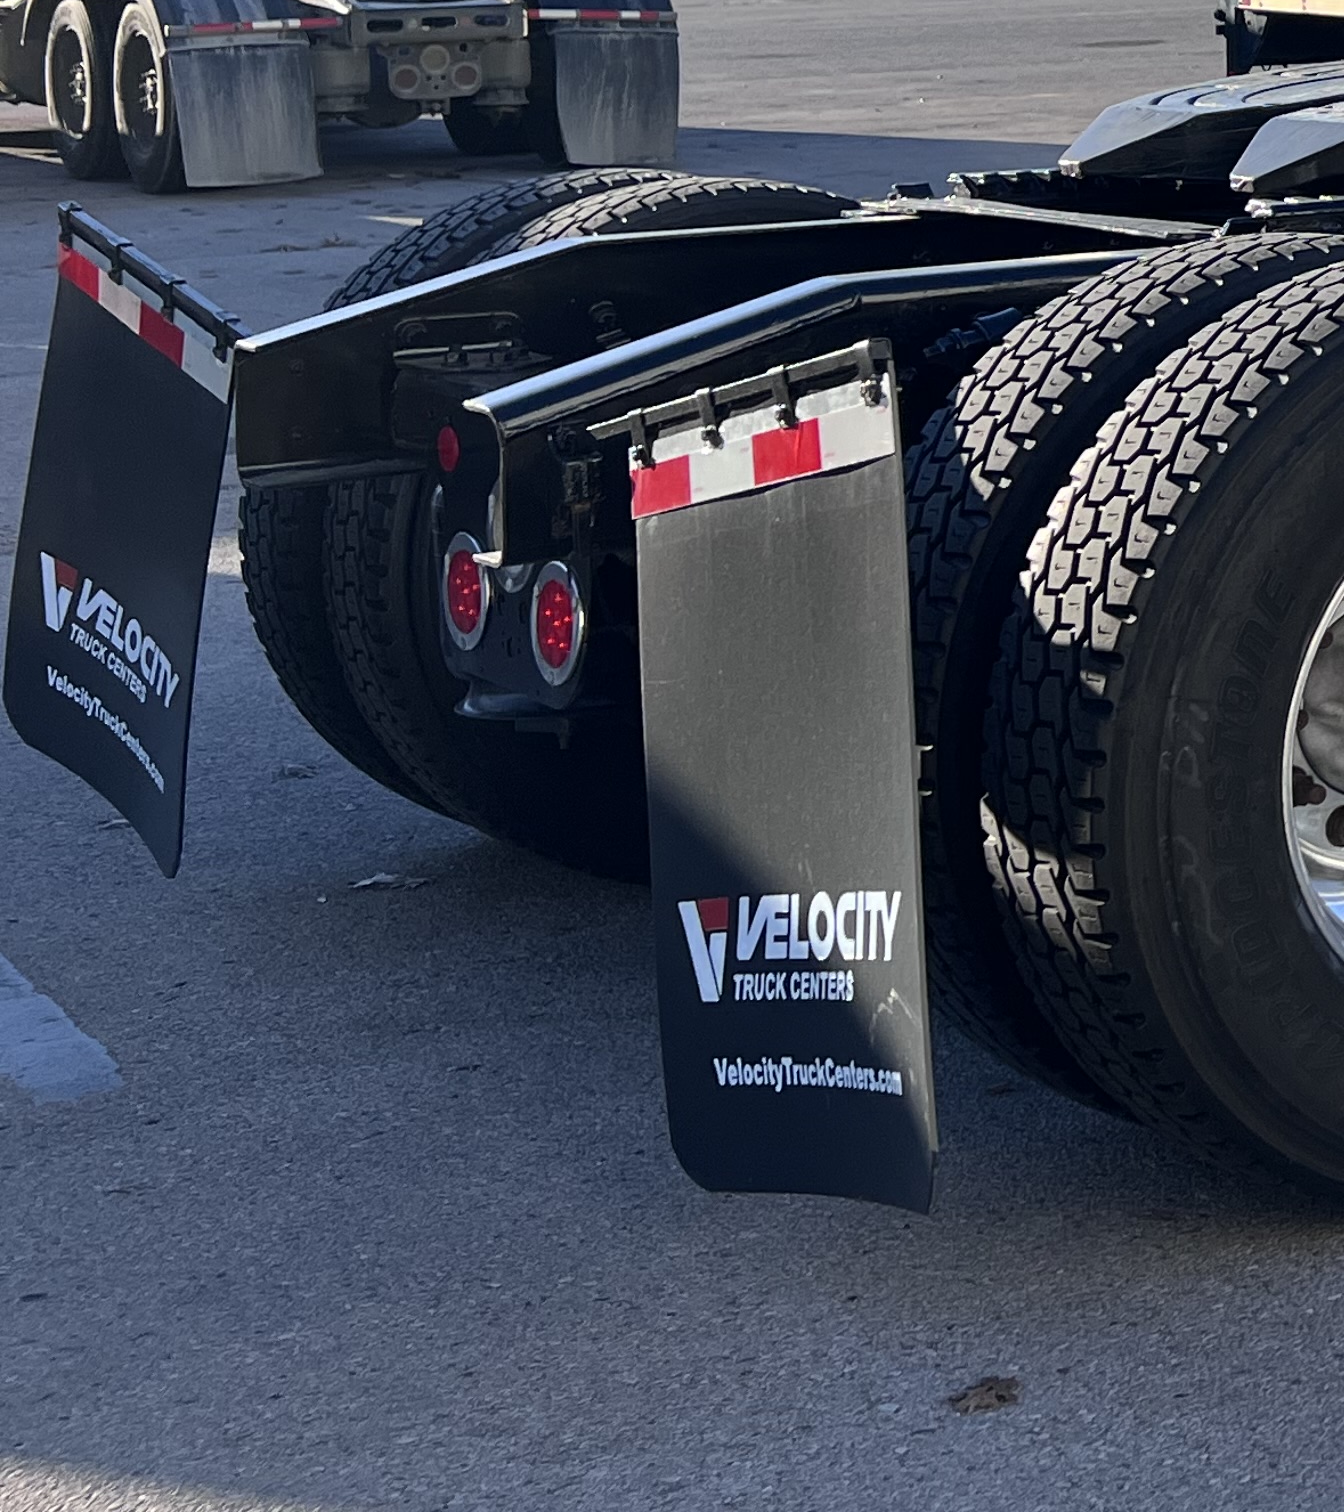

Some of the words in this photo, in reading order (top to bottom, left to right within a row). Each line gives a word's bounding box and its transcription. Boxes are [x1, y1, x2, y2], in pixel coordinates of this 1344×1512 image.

[69, 622, 107, 664] TRUCK
[76, 577, 181, 709] VELOCITY
[46, 664, 165, 794] VelocityTruckCt
[736, 890, 902, 962] VELOCITY
[732, 972, 788, 1001] TRUCK
[789, 969, 855, 1002] CENTERS
[713, 1056, 903, 1097] VelocityTruckCenters.com
